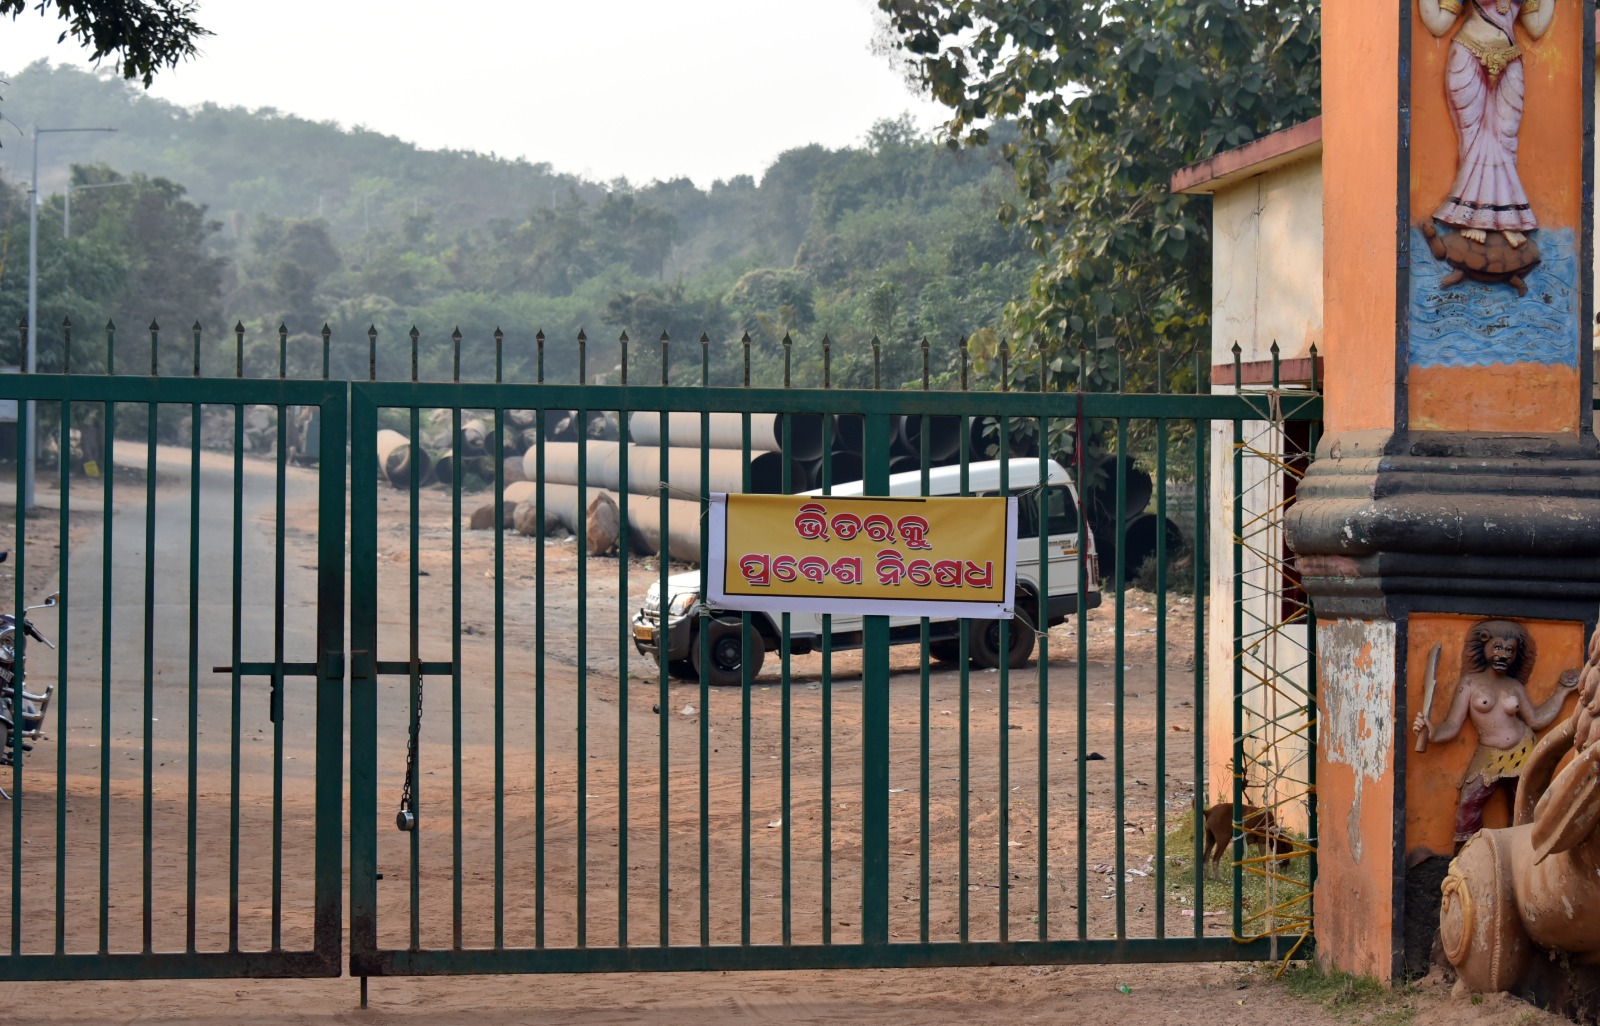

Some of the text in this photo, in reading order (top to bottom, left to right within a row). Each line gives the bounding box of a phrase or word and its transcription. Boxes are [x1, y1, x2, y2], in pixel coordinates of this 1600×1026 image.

[794, 503, 931, 548] ଭିତରକୁ
[739, 549, 994, 588] ପ୍ରବେଶ ନିଷେଧ
